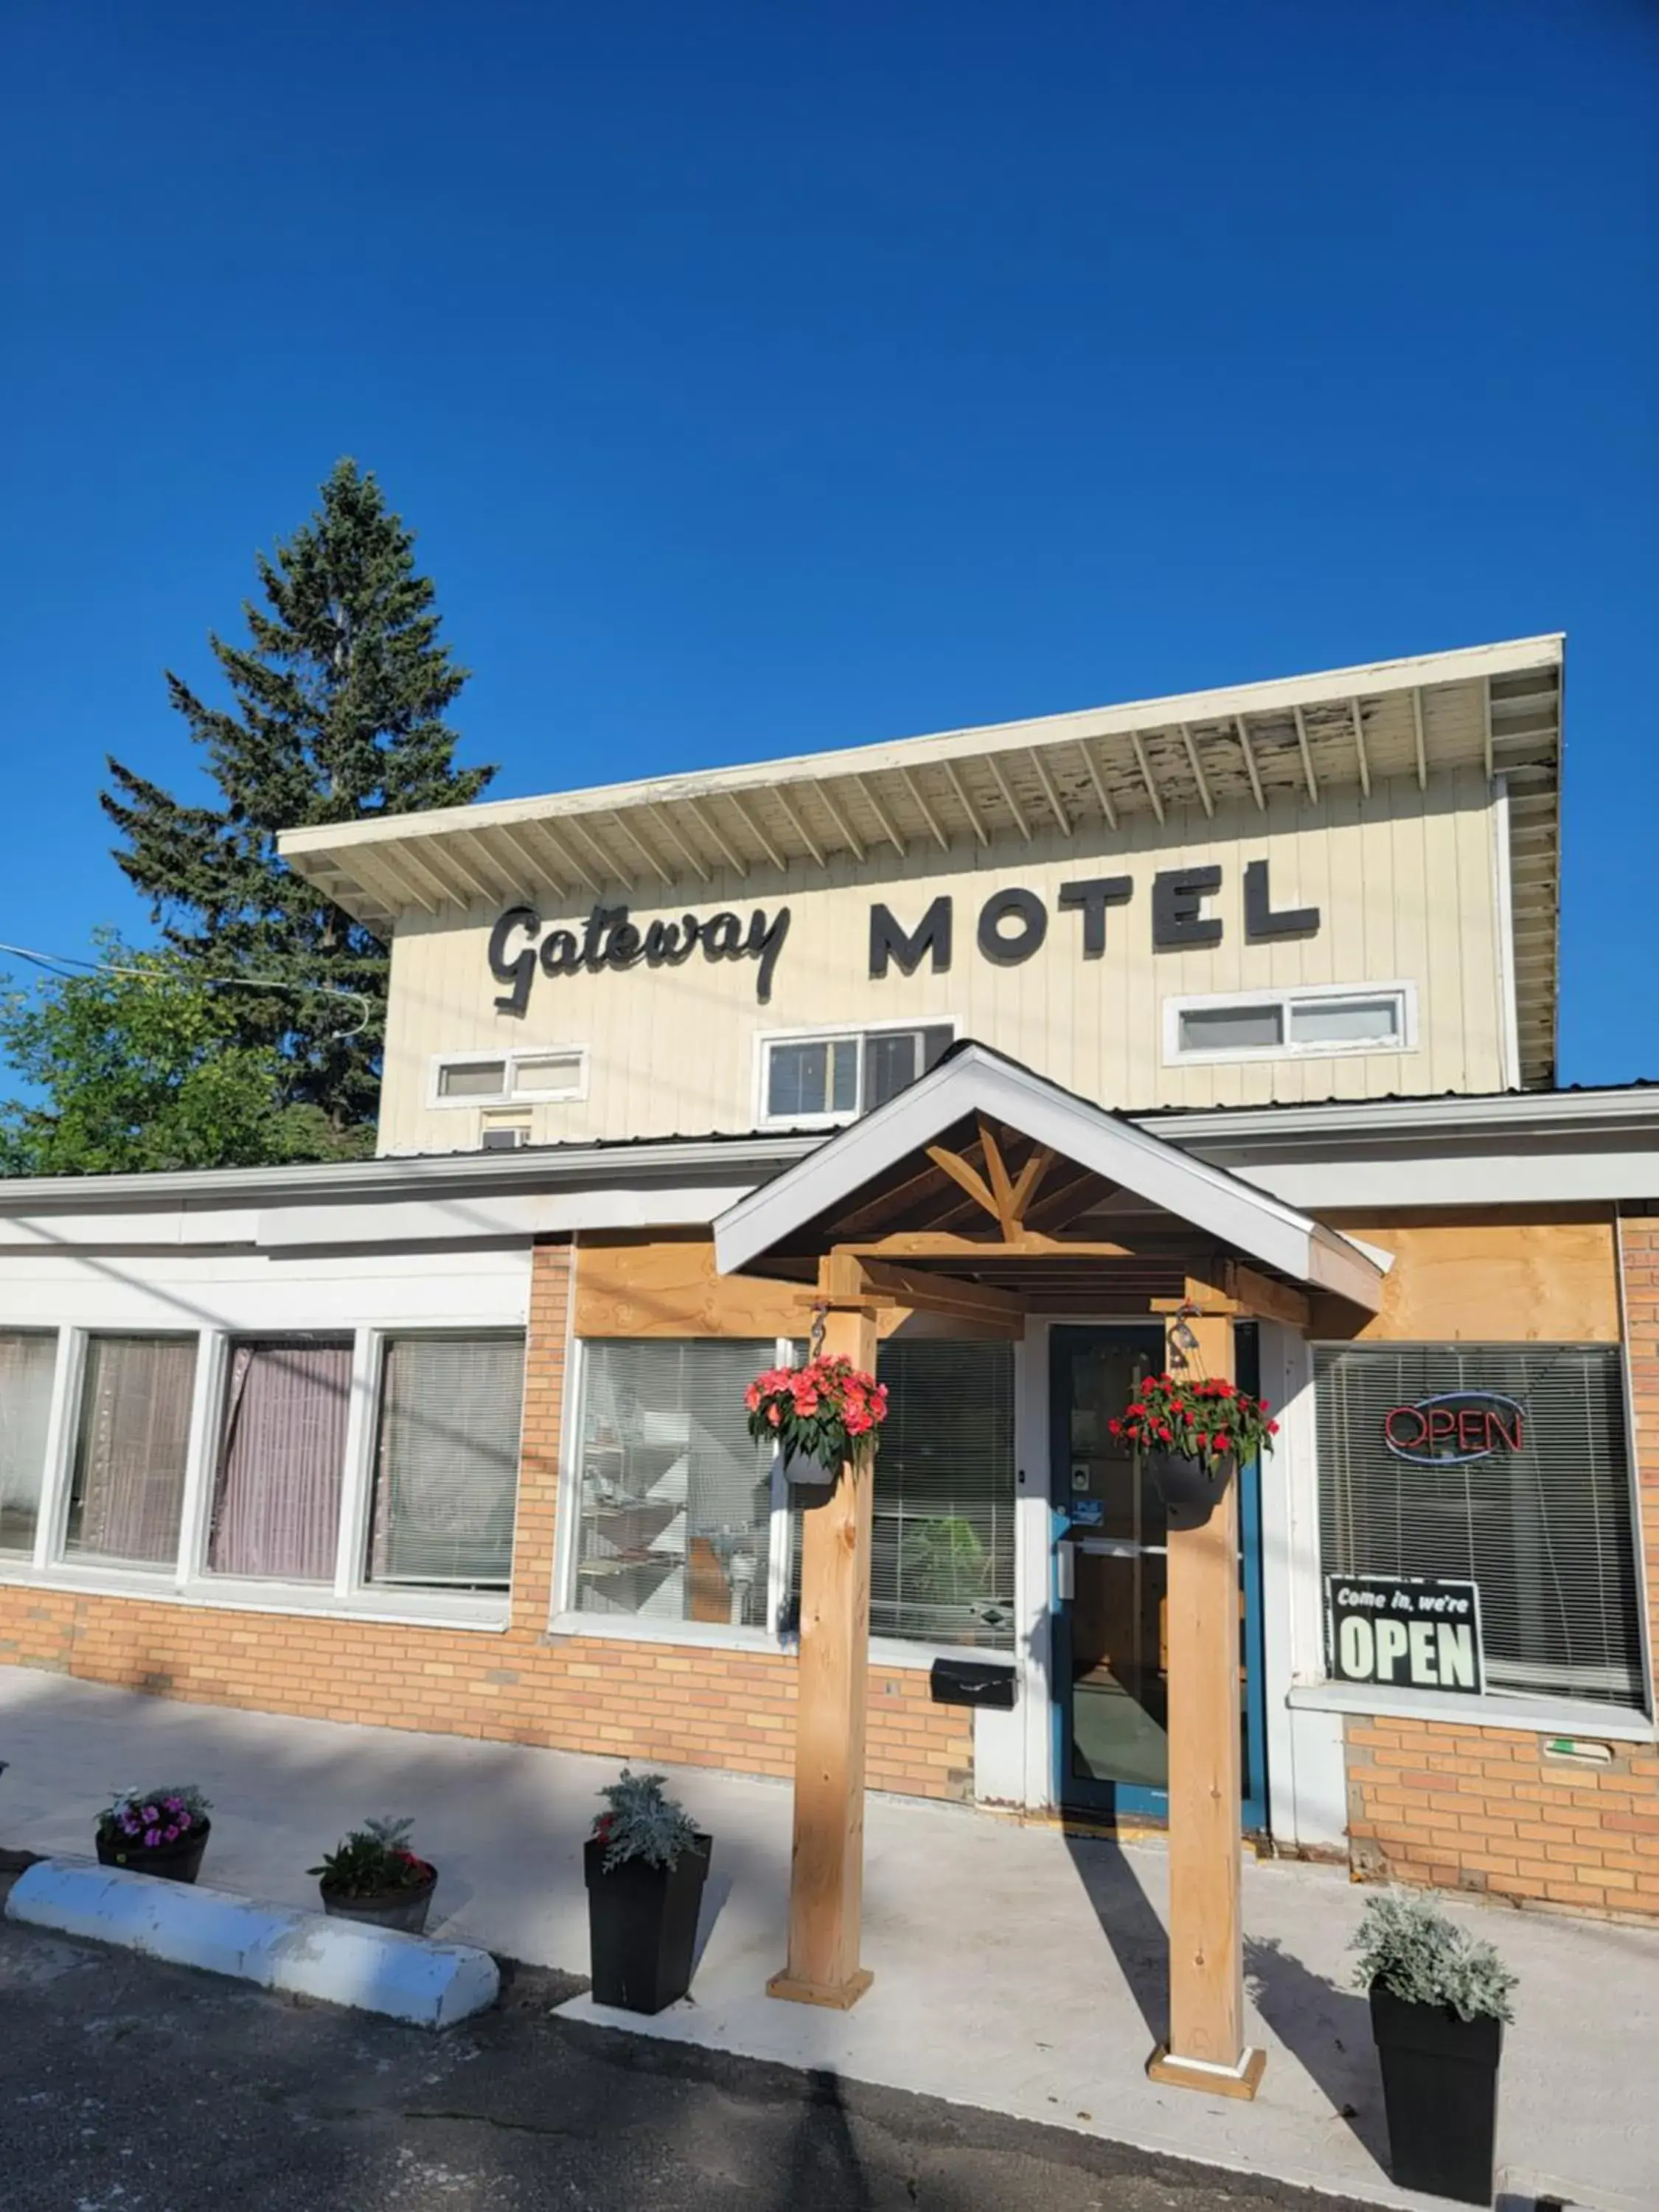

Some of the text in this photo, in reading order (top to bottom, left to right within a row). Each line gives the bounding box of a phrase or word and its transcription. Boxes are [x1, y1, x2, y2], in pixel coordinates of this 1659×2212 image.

[489, 859, 1321, 1018] Gateway MOTEL
[1385, 1406, 1523, 1452] OPEN
[1338, 1587, 1469, 1613] Come in, we're
[1340, 1615, 1475, 1687] OPEN
